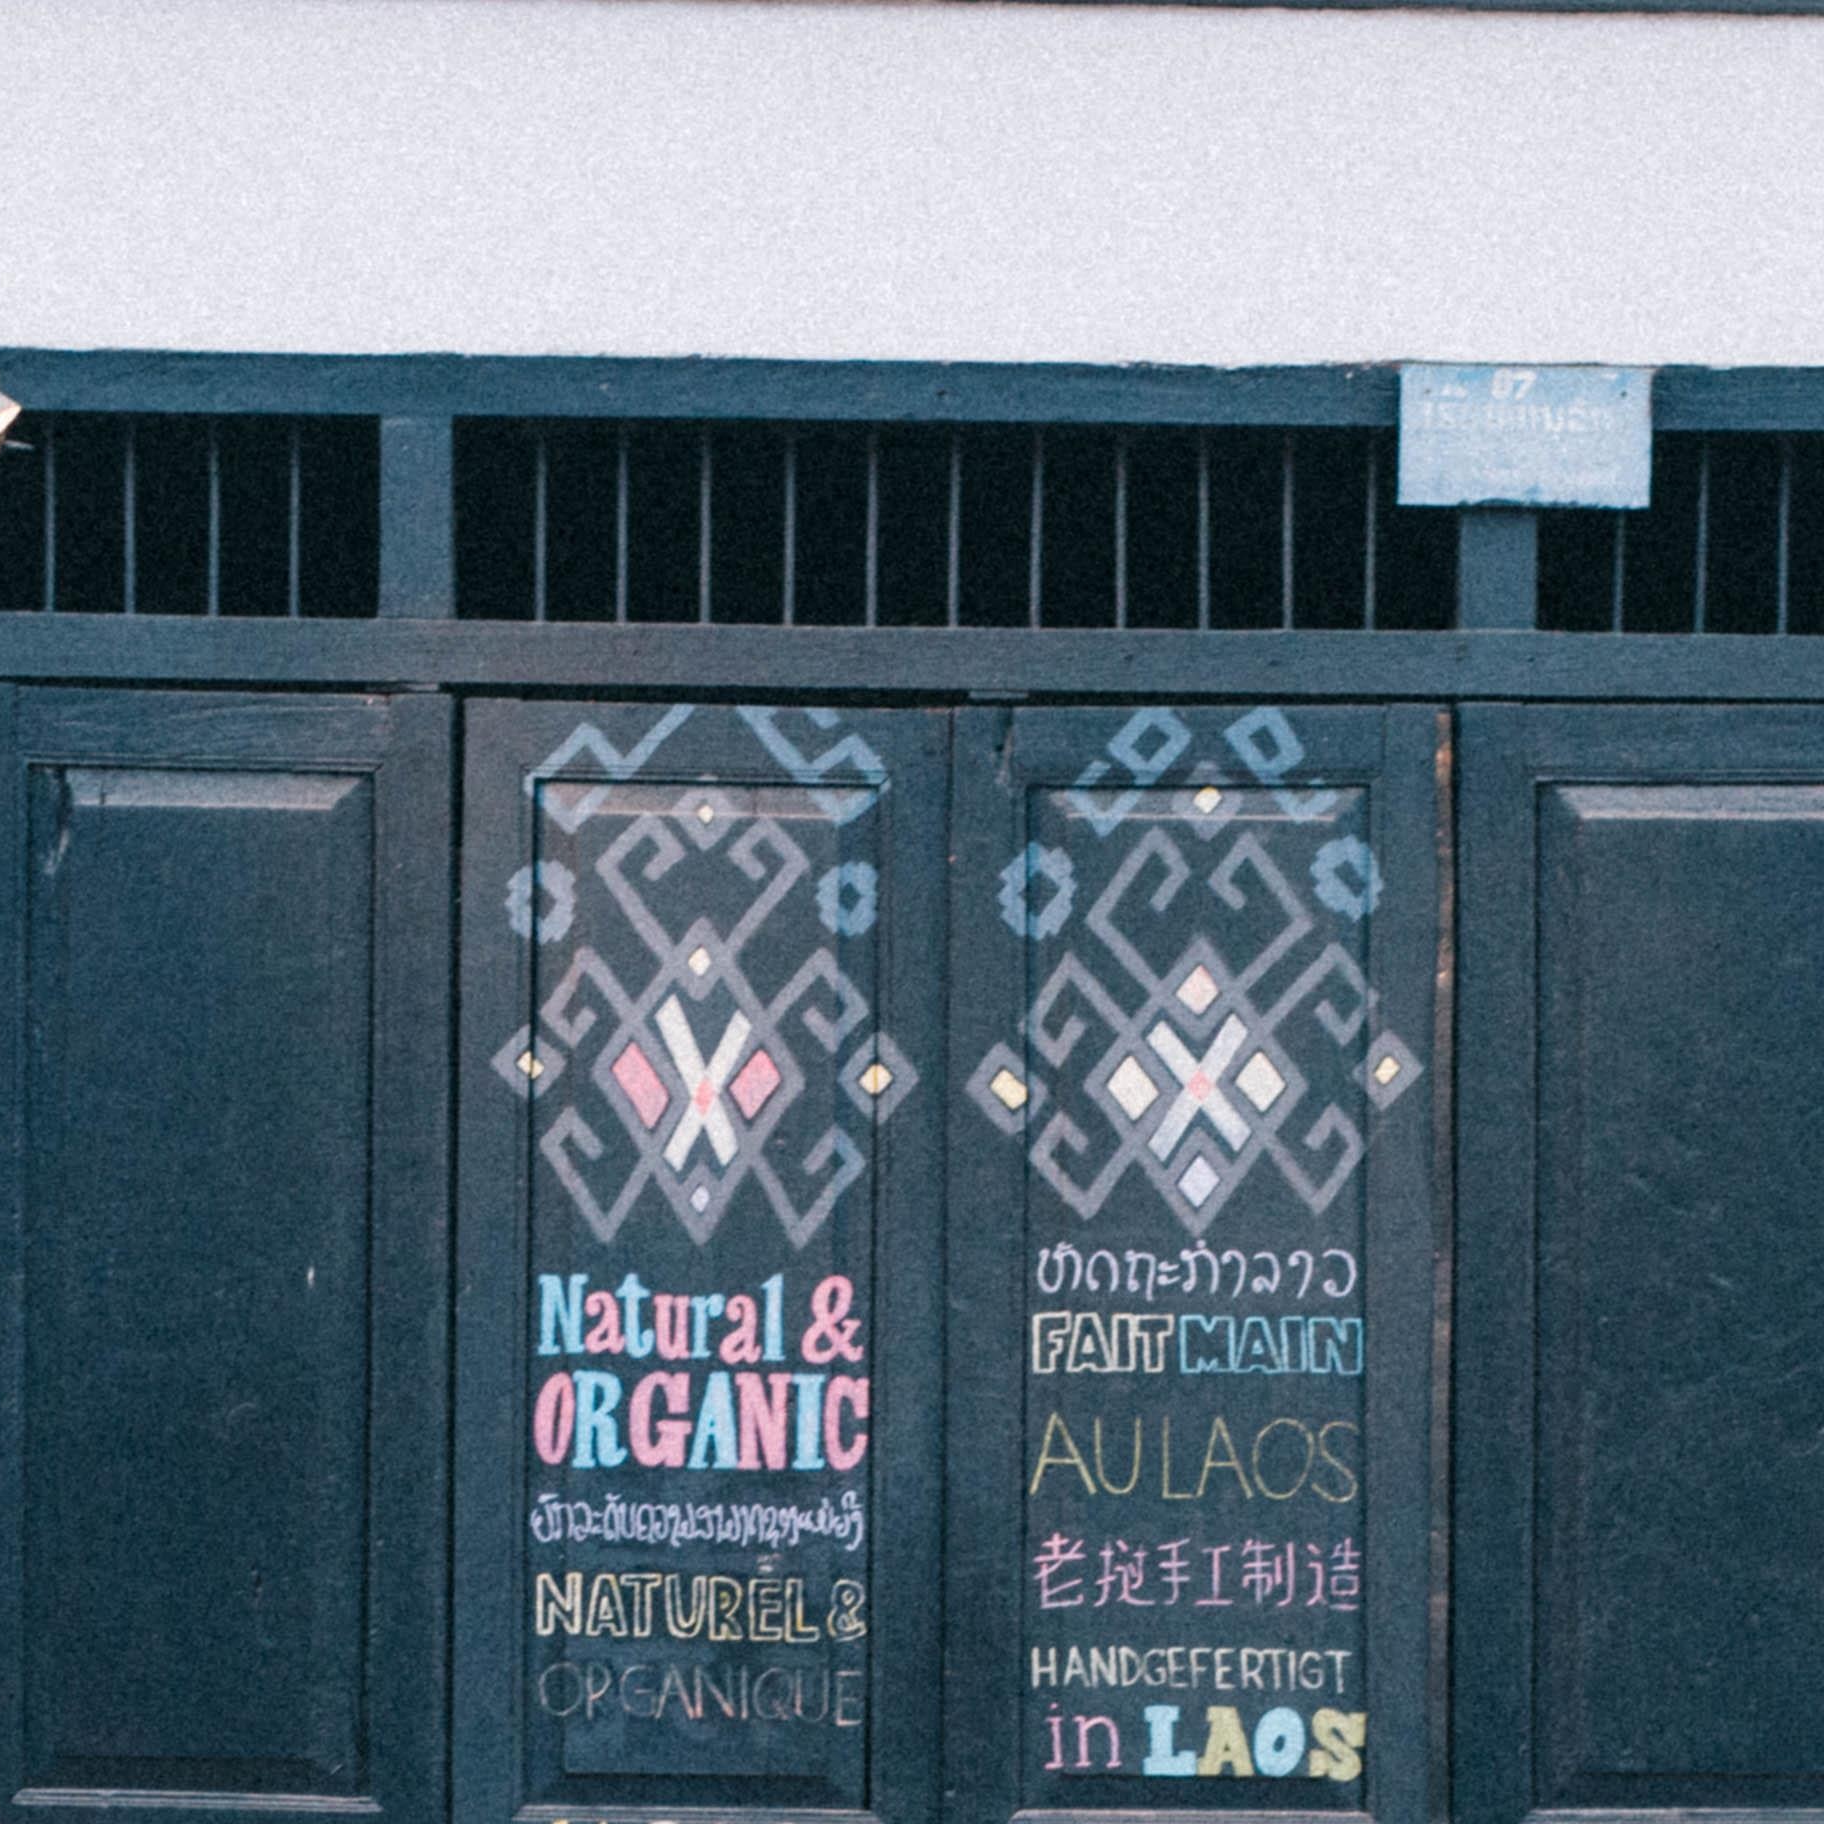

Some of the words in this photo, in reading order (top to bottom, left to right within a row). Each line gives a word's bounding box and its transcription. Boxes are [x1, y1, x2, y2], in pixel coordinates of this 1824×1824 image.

[537, 1272, 786, 1364] Natural
[802, 1275, 864, 1363] &
[1032, 1310, 1174, 1374] FAIT
[1179, 1313, 1364, 1375] MAIN
[533, 1369, 871, 1470] ORGANIC
[535, 1571, 821, 1643] NATUREL
[827, 1578, 868, 1642] &
[1033, 1532, 1361, 1611] 老挝手工制造
[1030, 1645, 1352, 1693] HANDGEFERTIGT
[1044, 1702, 1122, 1770] in
[1142, 1705, 1367, 1782] LAOS
